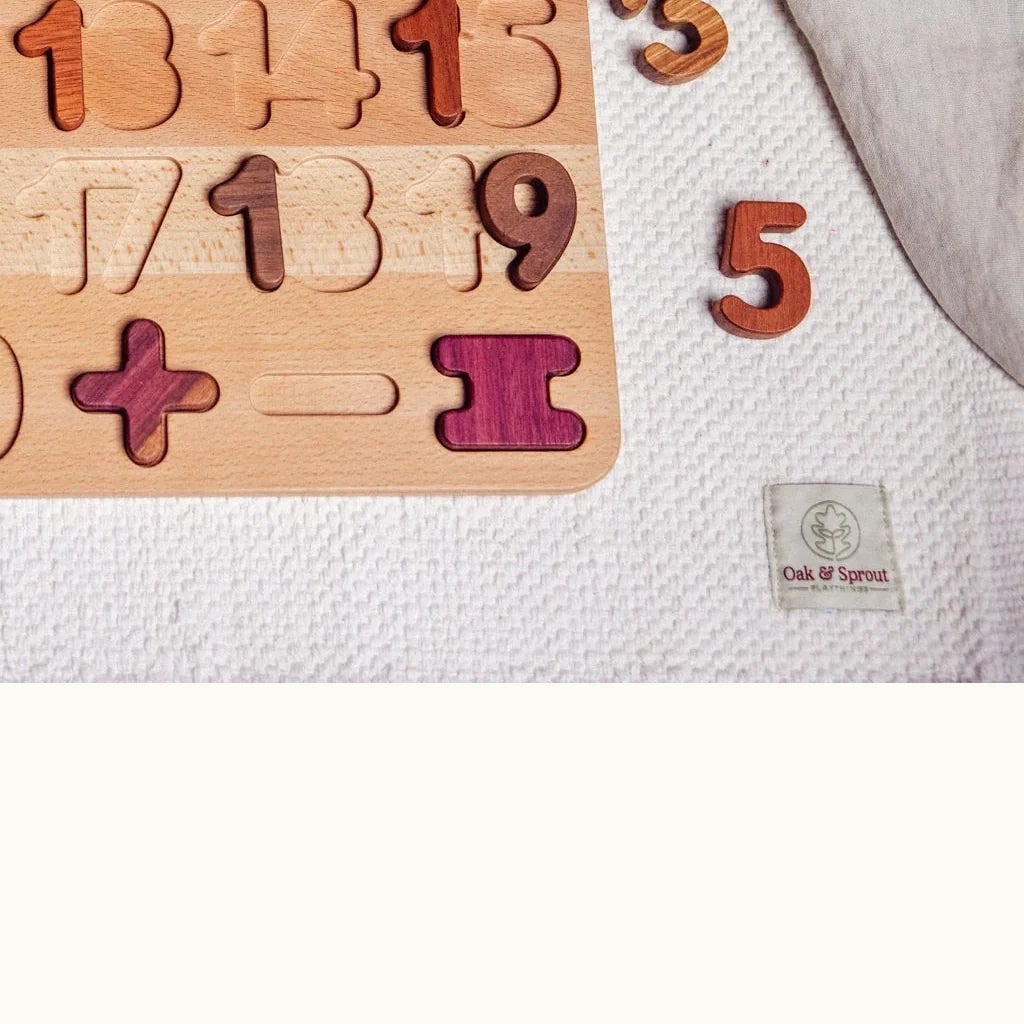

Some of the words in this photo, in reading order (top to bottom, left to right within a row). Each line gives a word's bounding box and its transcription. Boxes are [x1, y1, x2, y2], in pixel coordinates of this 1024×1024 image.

[15, 155, 184, 296] 17
[405, 151, 578, 292] 19
[711, 200, 812, 340] 5
[783, 565, 815, 581] Oak
[818, 565, 834, 580] &
[838, 566, 890, 585] Sprout
